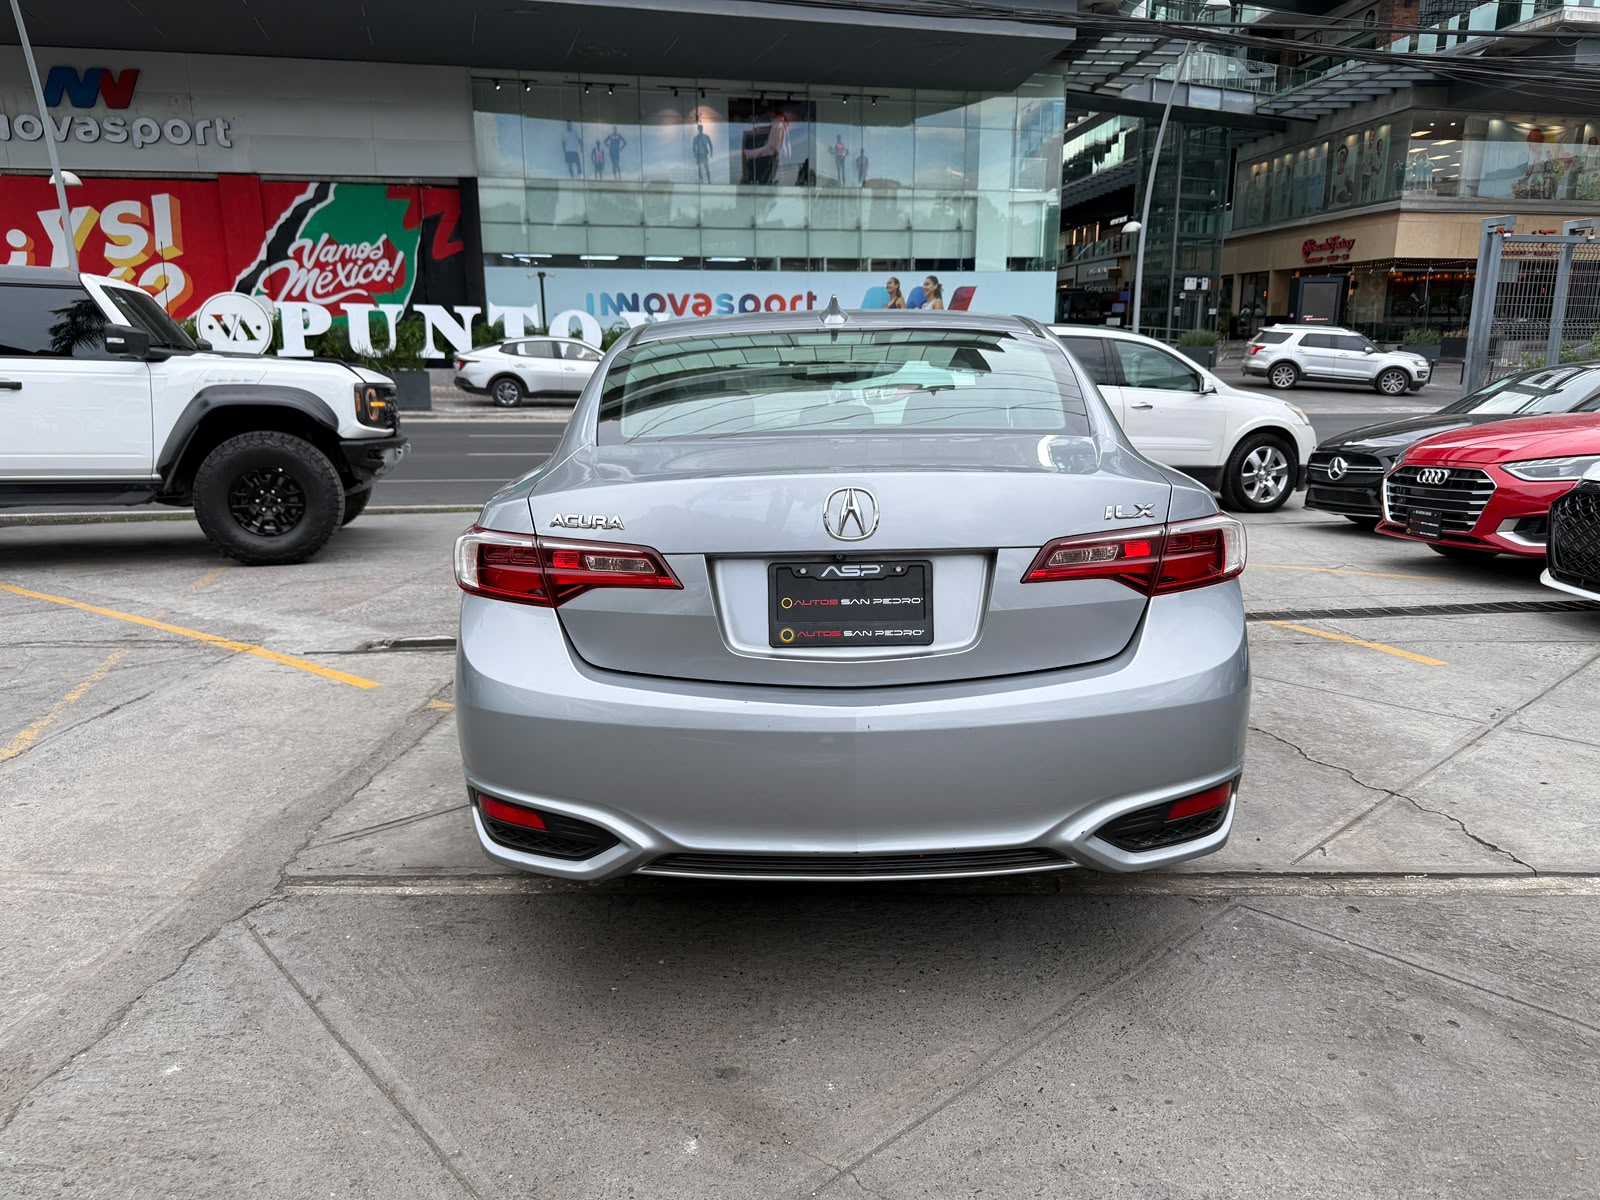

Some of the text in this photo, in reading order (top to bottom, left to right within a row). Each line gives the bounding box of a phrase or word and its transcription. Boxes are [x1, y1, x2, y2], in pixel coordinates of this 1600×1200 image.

[287, 233, 388, 269] Vamos
[258, 251, 405, 304] México!
[273, 300, 603, 359] PUNTO
[1104, 503, 1155, 520] ILX
[550, 513, 625, 530] ACURA
[820, 564, 881, 577] ASP
[873, 597, 921, 605] PEDRO
